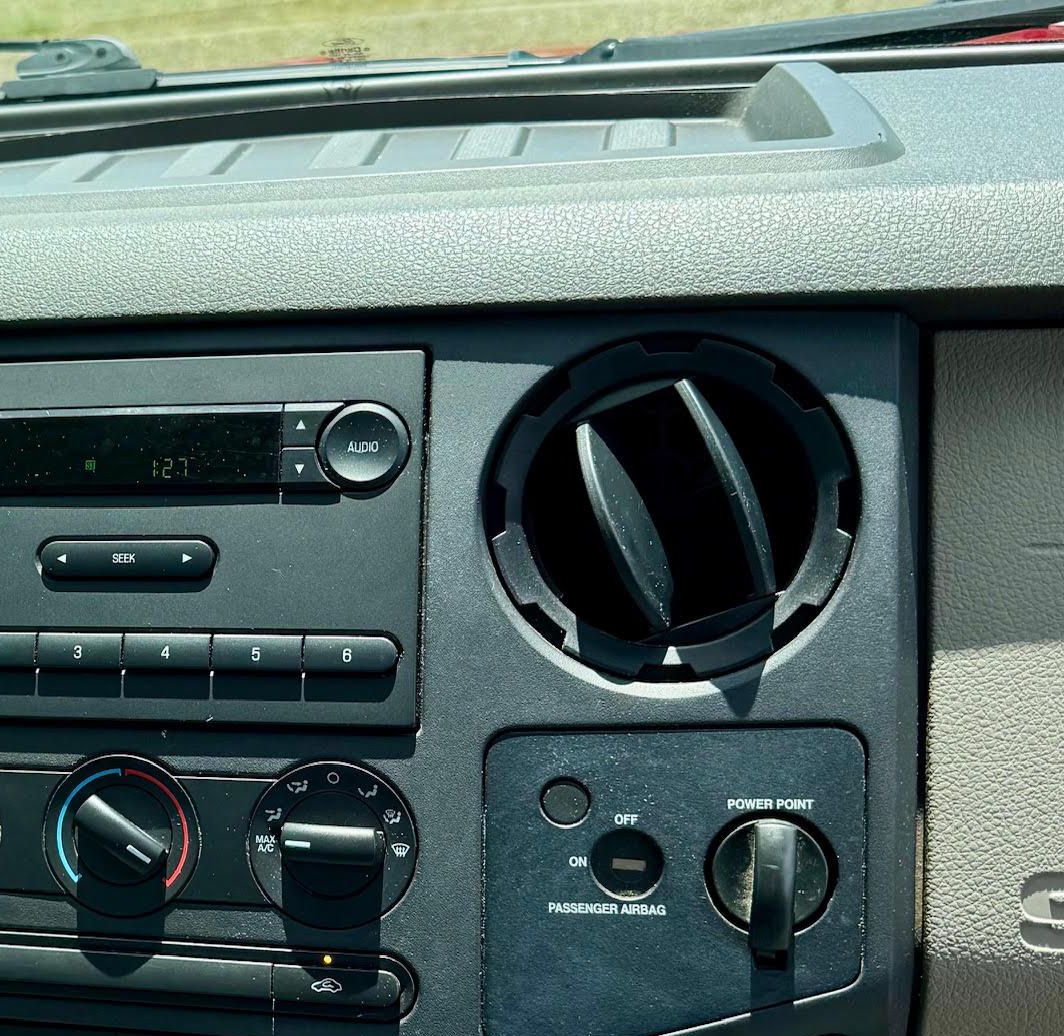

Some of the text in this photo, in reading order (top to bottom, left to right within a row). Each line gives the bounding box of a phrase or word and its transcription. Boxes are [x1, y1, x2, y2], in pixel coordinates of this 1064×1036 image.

[347, 440, 379, 453] AUDIO
[153, 458, 188, 478] 1:27
[112, 553, 136, 564] SEEK
[73, 645, 82, 659] 3
[161, 645, 170, 659] 4
[251, 647, 261, 661] 5
[342, 648, 352, 662] 6
[727, 799, 814, 810] POWER POINT
[614, 814, 638, 825] OFF
[255, 834, 276, 844] MAX
[257, 844, 274, 853] A/C
[569, 856, 587, 867] ON
[548, 903, 666, 916] PASSENGER AIRBAG
